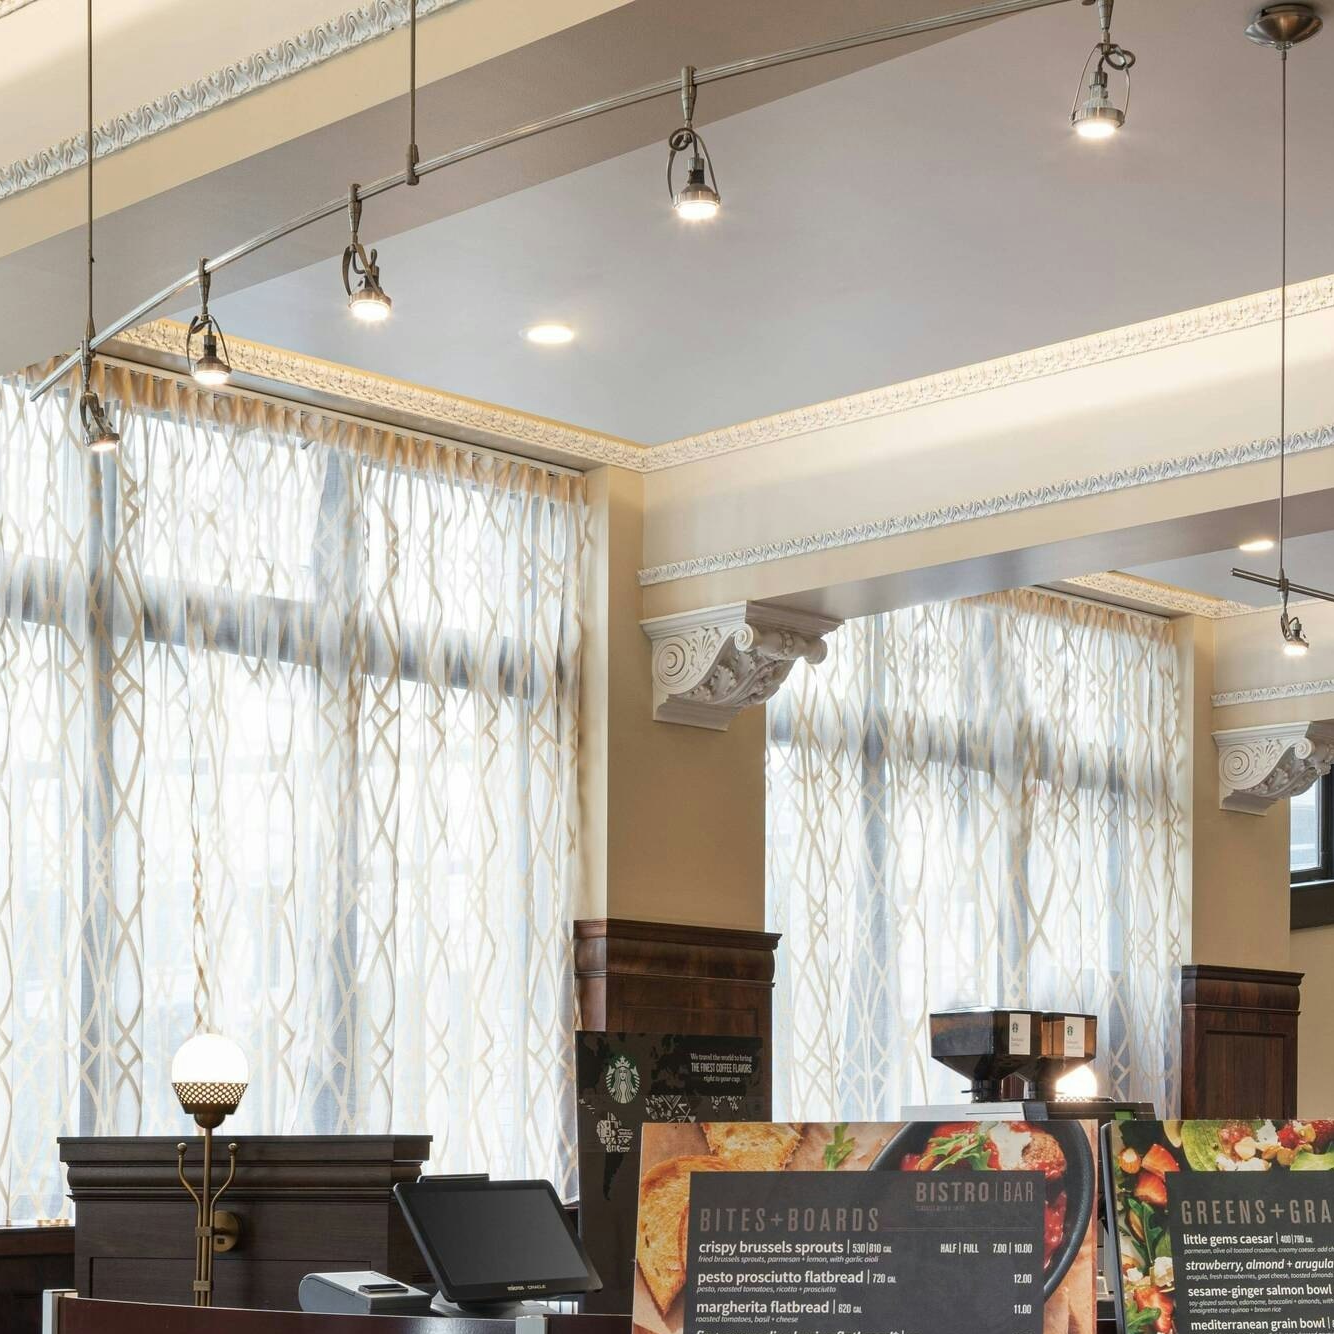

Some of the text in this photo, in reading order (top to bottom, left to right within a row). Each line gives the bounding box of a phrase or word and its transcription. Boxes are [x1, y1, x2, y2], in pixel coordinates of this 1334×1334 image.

[916, 1181, 1034, 1203] BISTRO BAR
[699, 1240, 1033, 1256] crispy brussels sprouts HALF FULL 7.00 10.00
[1183, 1233, 1274, 1247] little gems caesar
[698, 1255, 880, 1264] fried brussels sprouts, parmesan lemon, with garlic aioli
[1185, 1259, 1244, 1273] strawberry,
[1245, 1258, 1285, 1270] almond
[1294, 1258, 1334, 1271] arugula
[698, 1270, 886, 1286] pesto prosciutto flatbread 720
[1188, 1285, 1265, 1299] sesame-ginger
[1266, 1284, 1305, 1296] salmon
[1306, 1283, 1333, 1295] bowl
[696, 1300, 1032, 1317] margherita flatbread 11.00
[1191, 1317, 1326, 1332] mediterranean grain bowl
